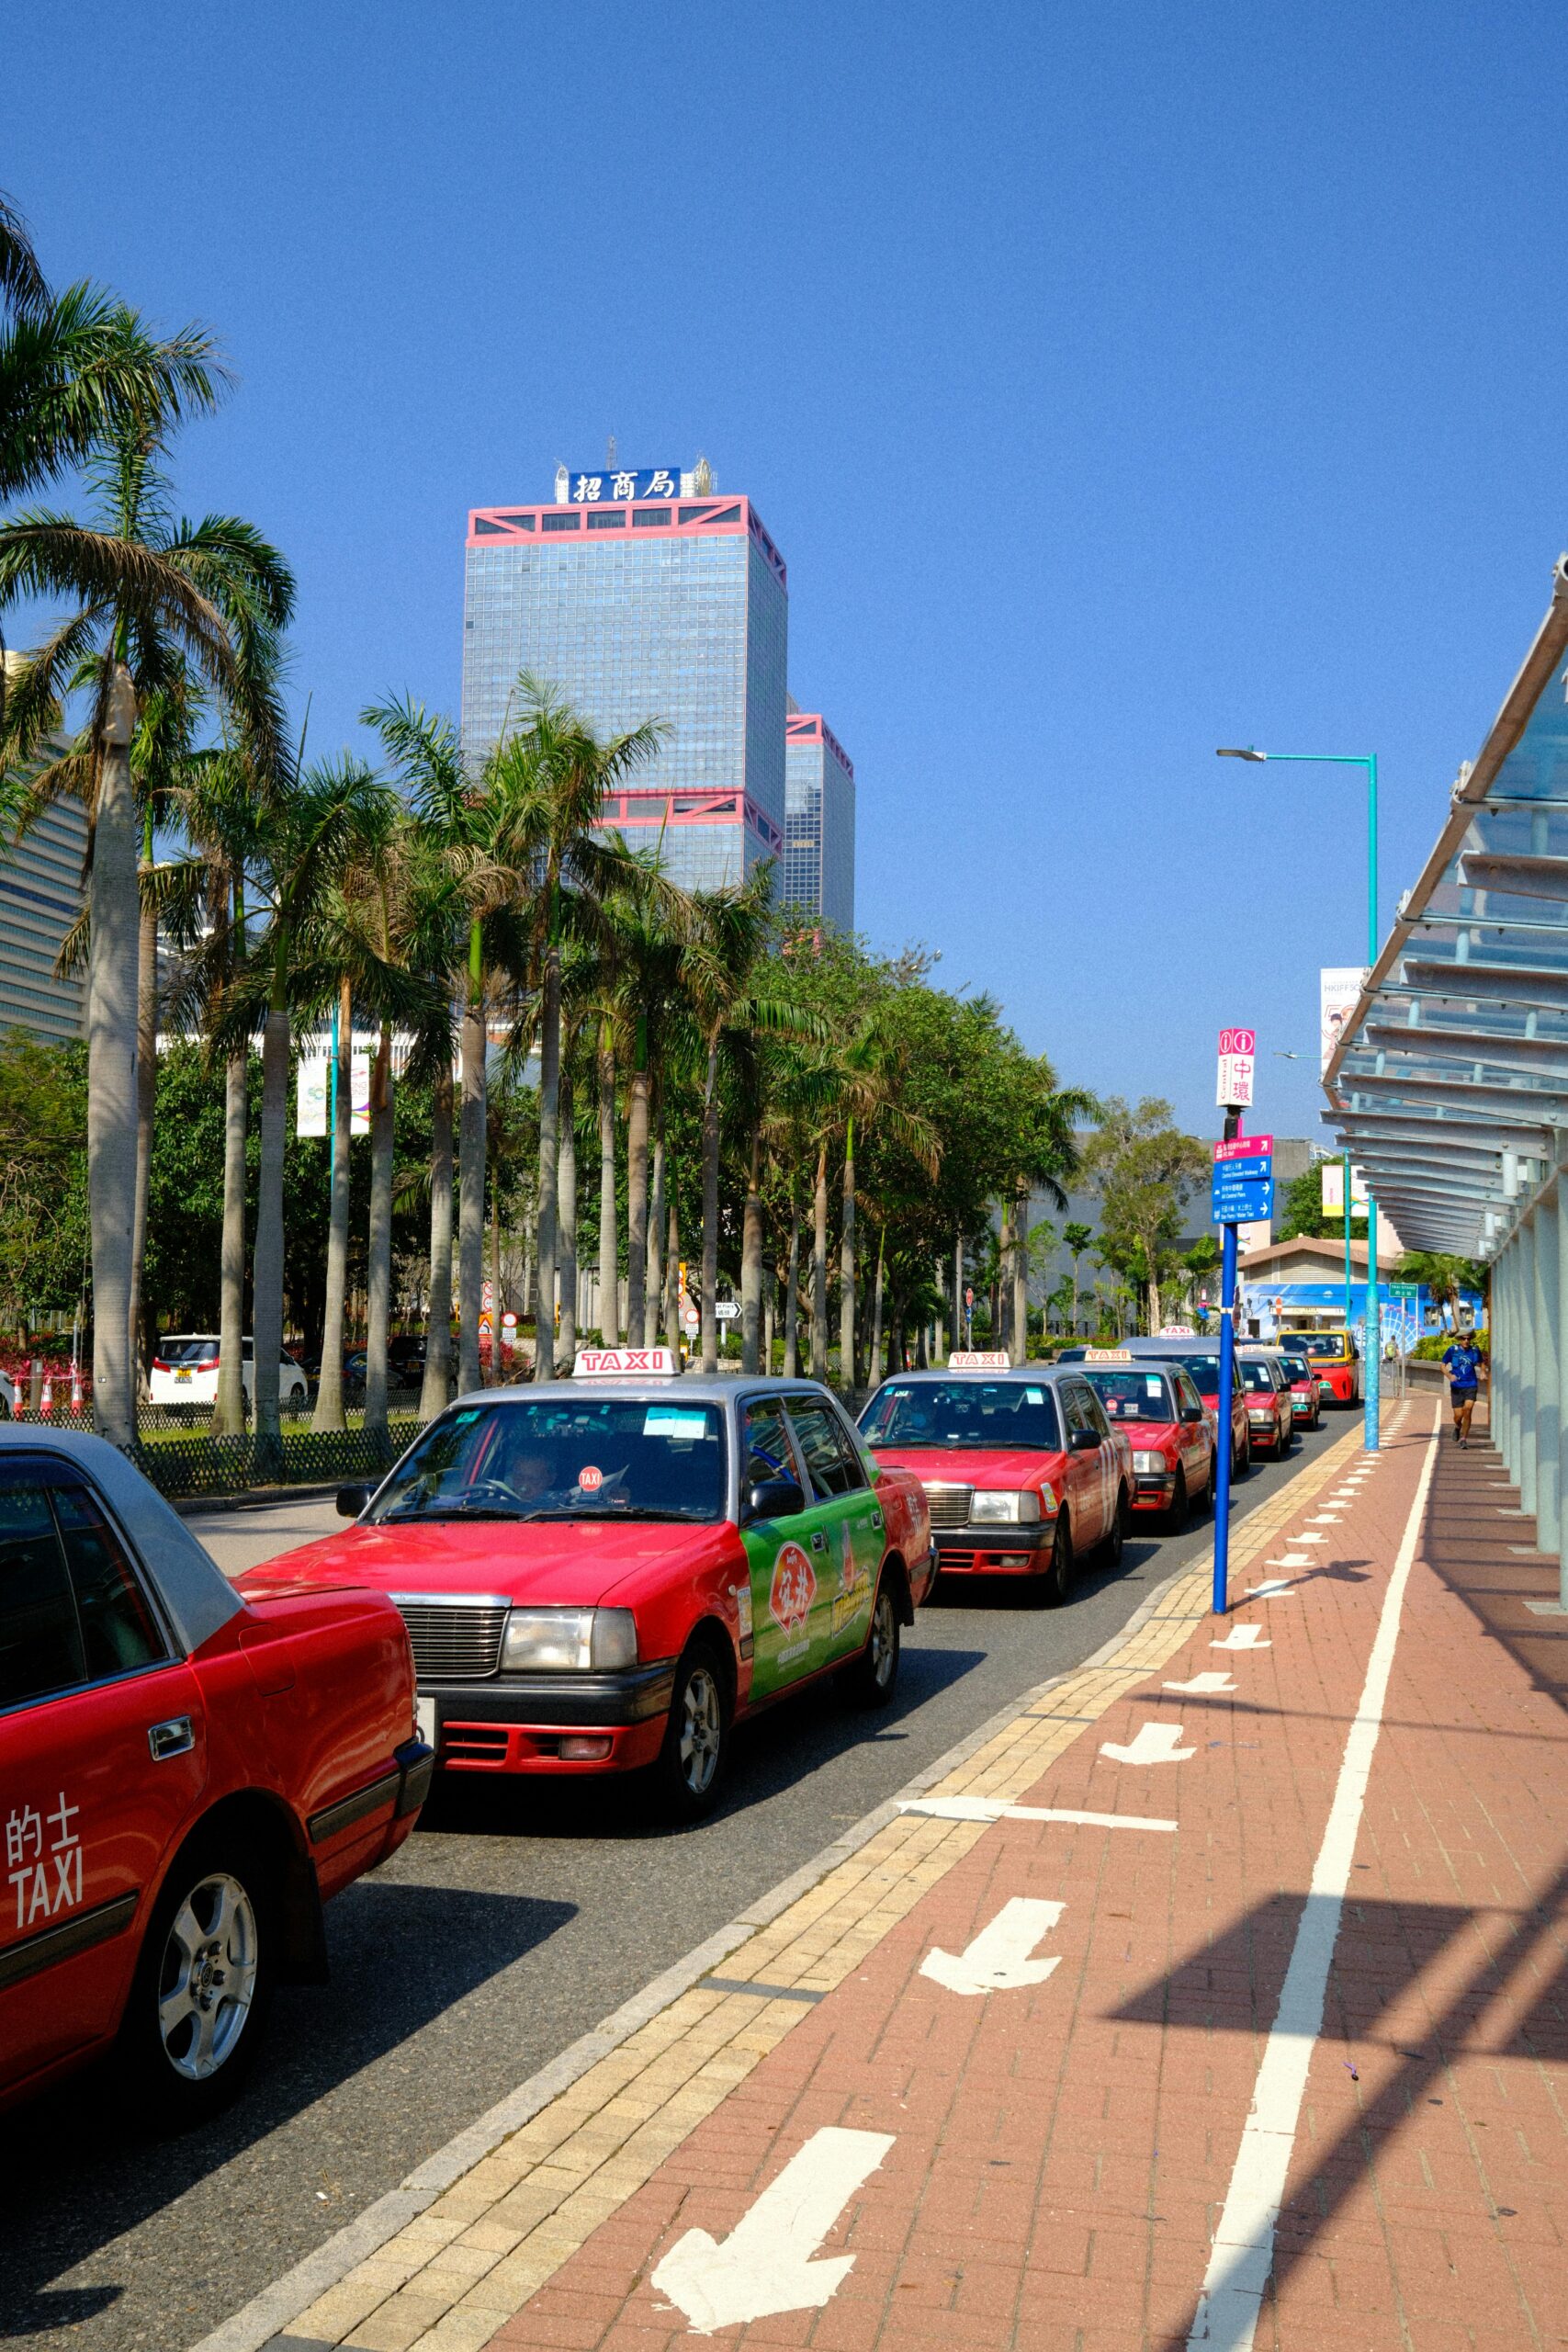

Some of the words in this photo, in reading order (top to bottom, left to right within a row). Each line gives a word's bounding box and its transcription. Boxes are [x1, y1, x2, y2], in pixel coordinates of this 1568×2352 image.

[573, 469, 675, 503] 招商局
[1220, 1058, 1228, 1100] Central
[1233, 1059, 1251, 1101] 中環
[581, 1351, 663, 1371] TAXI
[954, 1353, 1005, 1365] TAXI
[1088, 1351, 1128, 1360] TAXI
[581, 1473, 600, 1486] TAXI
[6, 1792, 80, 1869] 的士
[8, 1846, 83, 1929] TAXI
